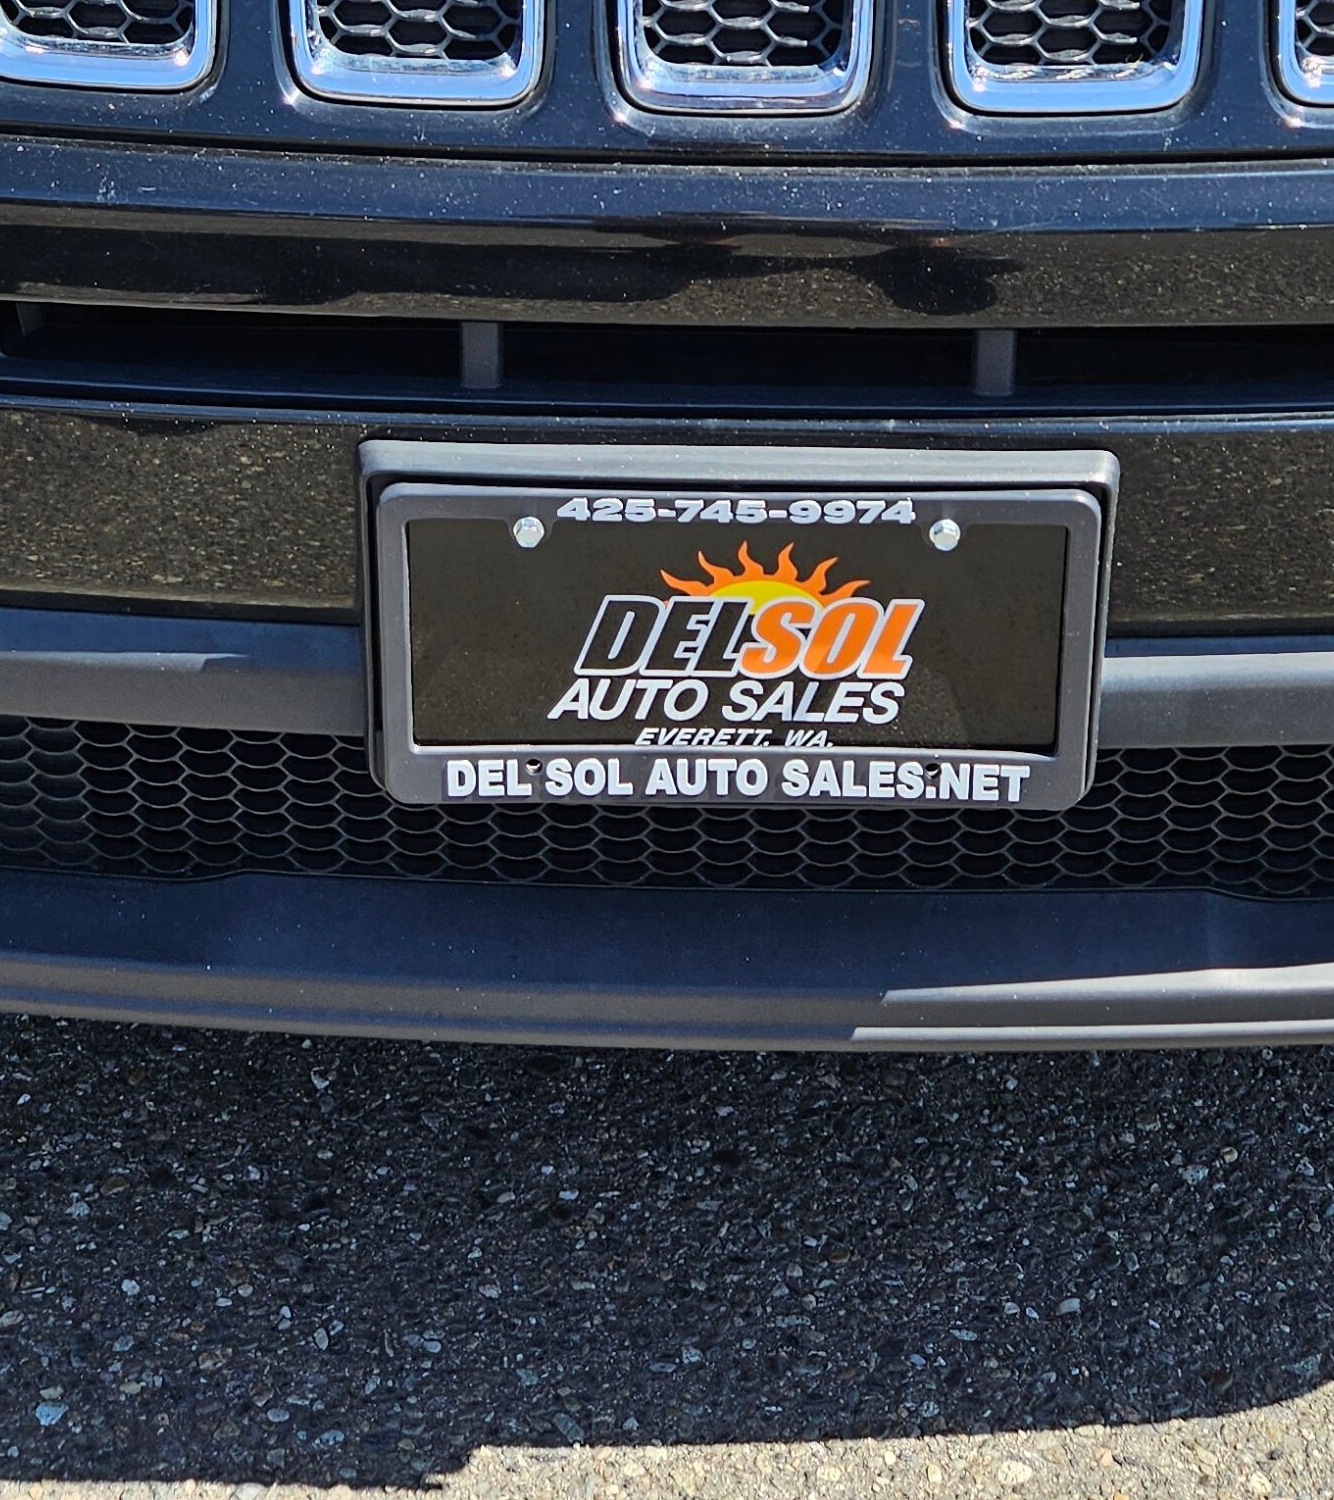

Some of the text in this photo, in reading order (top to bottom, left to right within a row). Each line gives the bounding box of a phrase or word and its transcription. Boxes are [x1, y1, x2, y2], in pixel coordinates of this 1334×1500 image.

[556, 497, 916, 525] 425-745-9974
[548, 680, 906, 724] AUTO SALES
[447, 759, 1031, 802] DEL SOL AUTO SALES.NET
